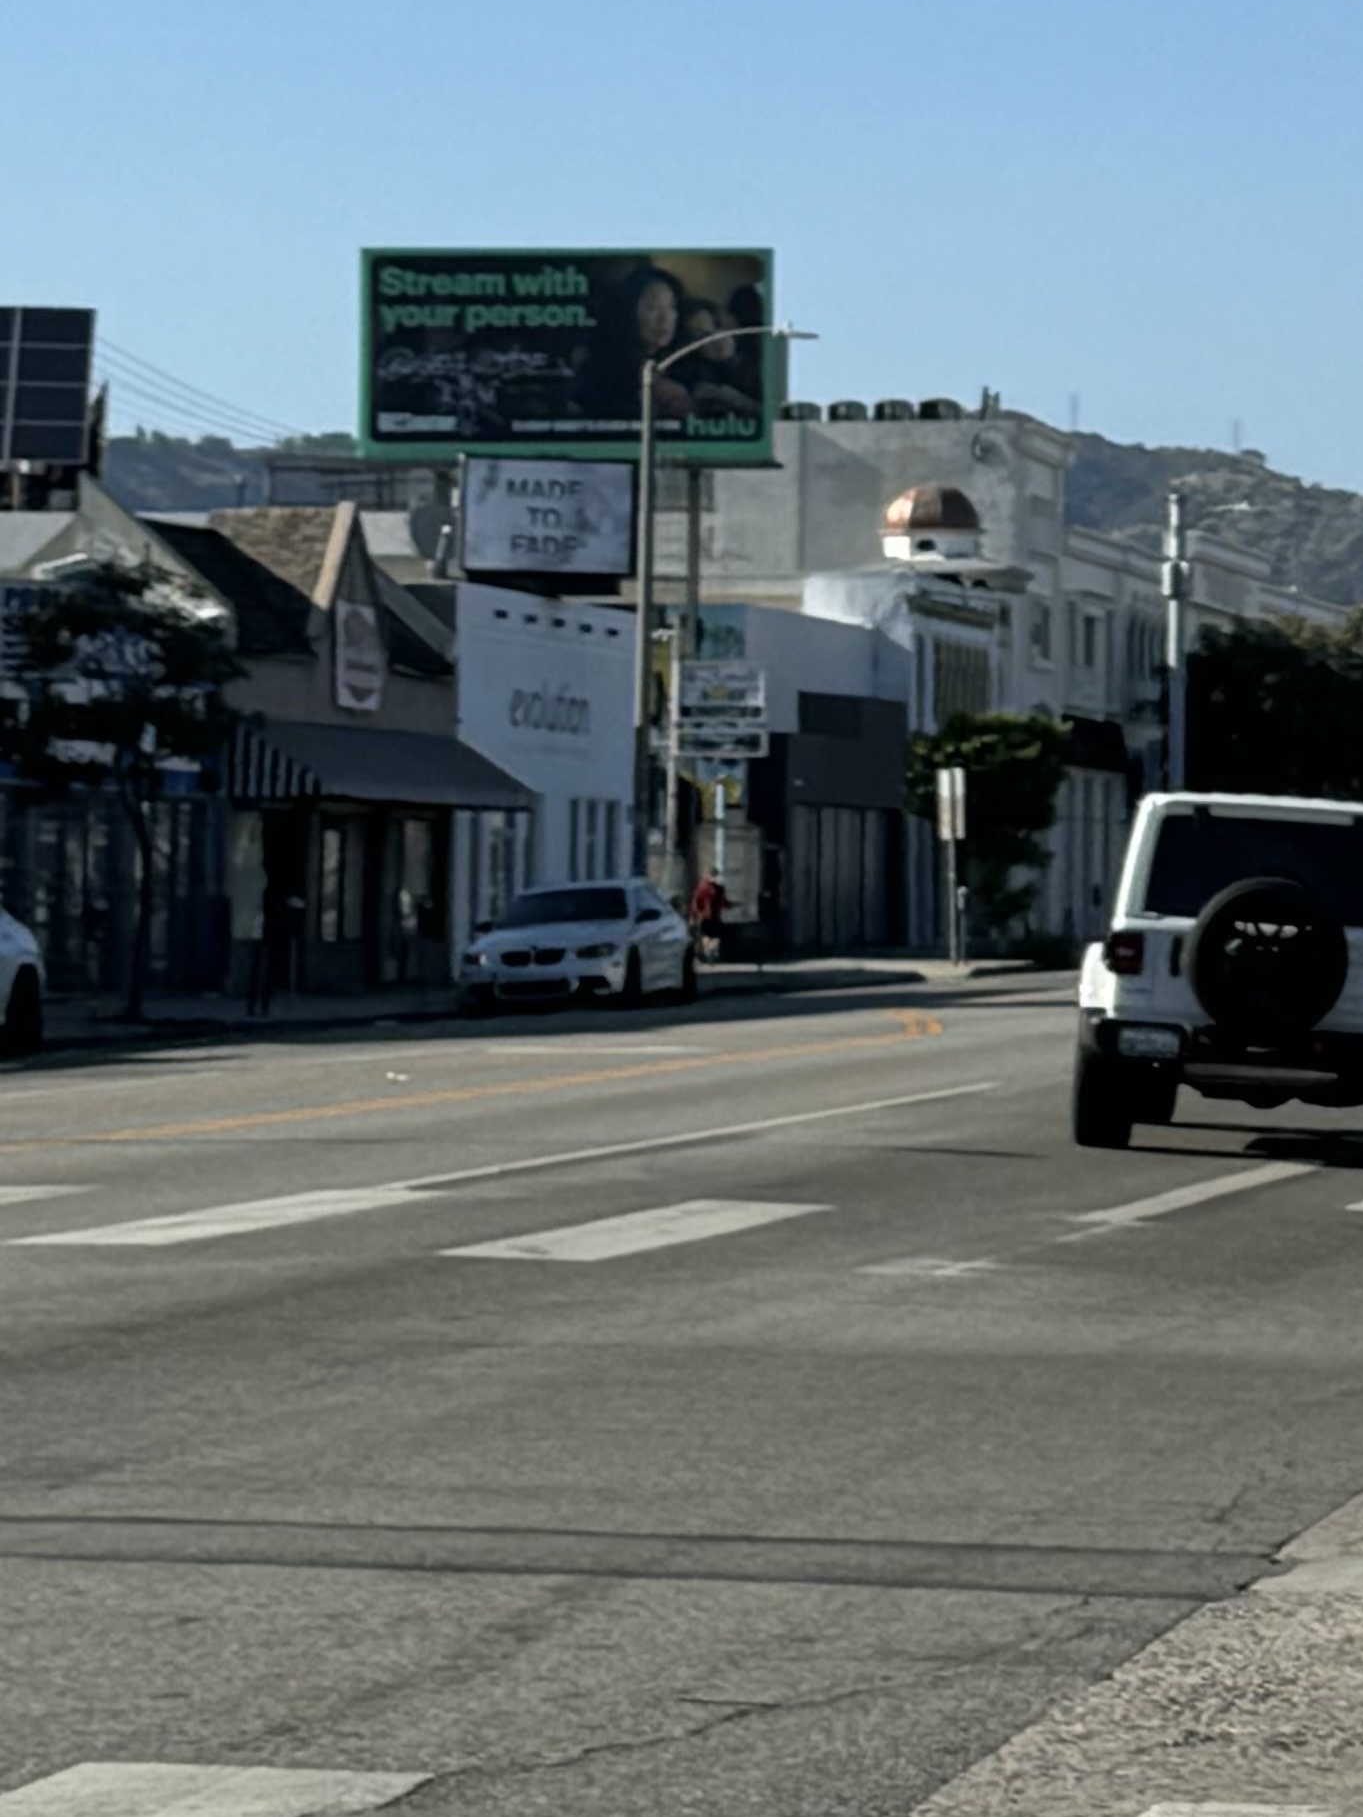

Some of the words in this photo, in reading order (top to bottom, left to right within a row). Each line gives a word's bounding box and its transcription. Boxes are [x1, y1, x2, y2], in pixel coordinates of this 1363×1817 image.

[377, 265, 507, 297] Stream
[511, 264, 589, 295] with
[379, 304, 461, 333] your
[465, 304, 597, 333] person.
[686, 412, 758, 437] hulu
[505, 478, 585, 497] MADE
[525, 505, 562, 529] TO
[509, 532, 579, 556] FADE
